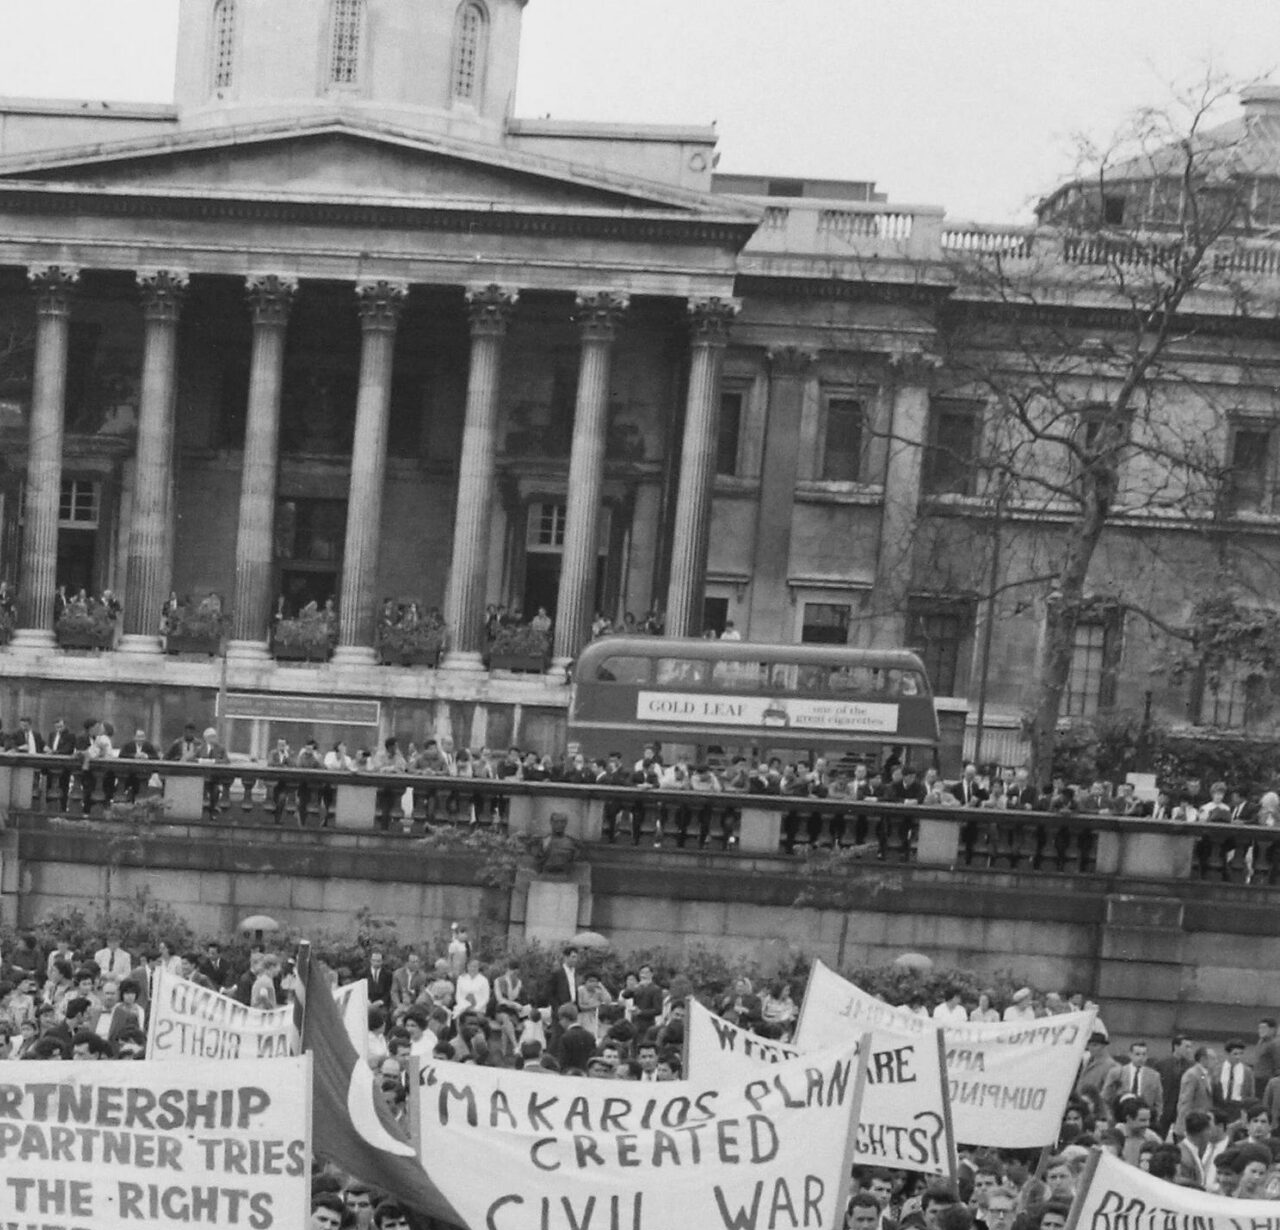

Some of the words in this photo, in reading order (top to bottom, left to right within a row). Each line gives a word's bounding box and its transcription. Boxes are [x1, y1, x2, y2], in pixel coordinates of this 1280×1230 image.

[649, 700, 695, 714] GOLD
[704, 702, 746, 717] LEAF
[795, 714, 826, 725] great
[827, 715, 885, 727] cigarettes
[835, 705, 847, 714] of
[849, 707, 867, 715] the
[529, 1113, 780, 1172] CREATED
[197, 1137, 306, 1178] TRIES
[6, 1176, 94, 1218] THE
[117, 1180, 274, 1230] RIGHTS
